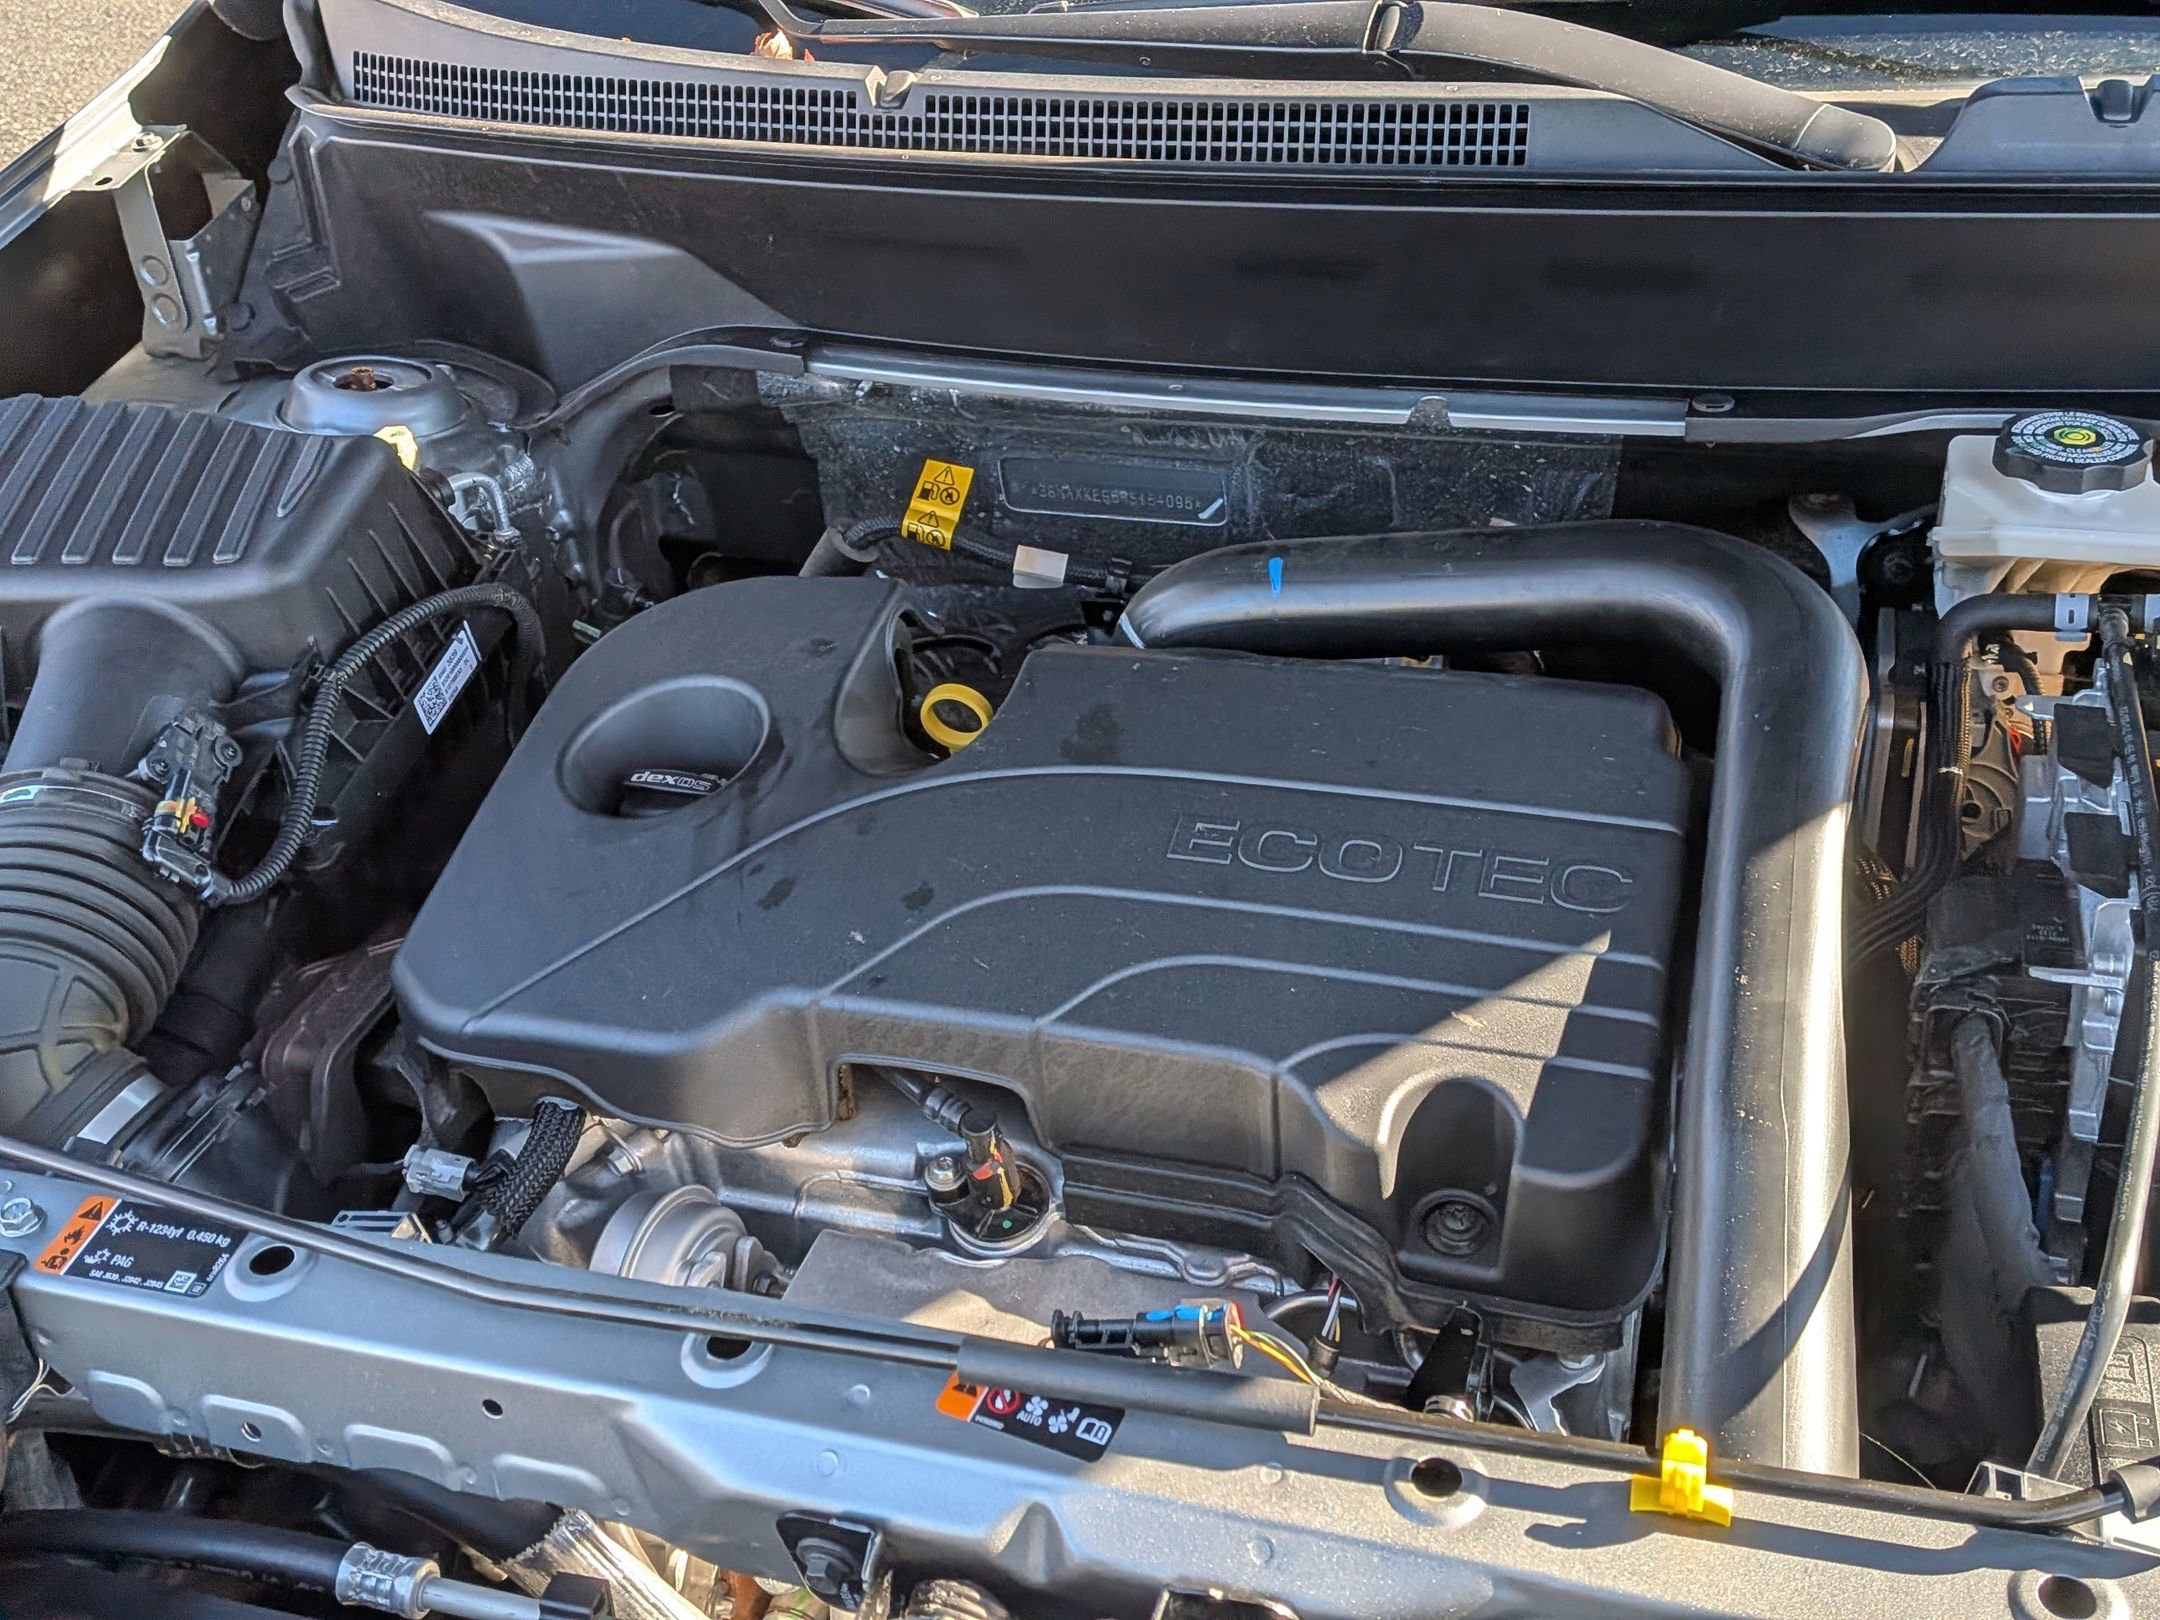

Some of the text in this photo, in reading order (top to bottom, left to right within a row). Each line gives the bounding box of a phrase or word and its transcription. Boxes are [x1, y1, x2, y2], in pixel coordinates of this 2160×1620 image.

[1167, 812, 1634, 913] ECOTEC
[136, 1221, 231, 1248] R-1234yf 0.450 kg
[110, 1254, 134, 1268] PAG
[1016, 1410, 1043, 1427] AUTO
